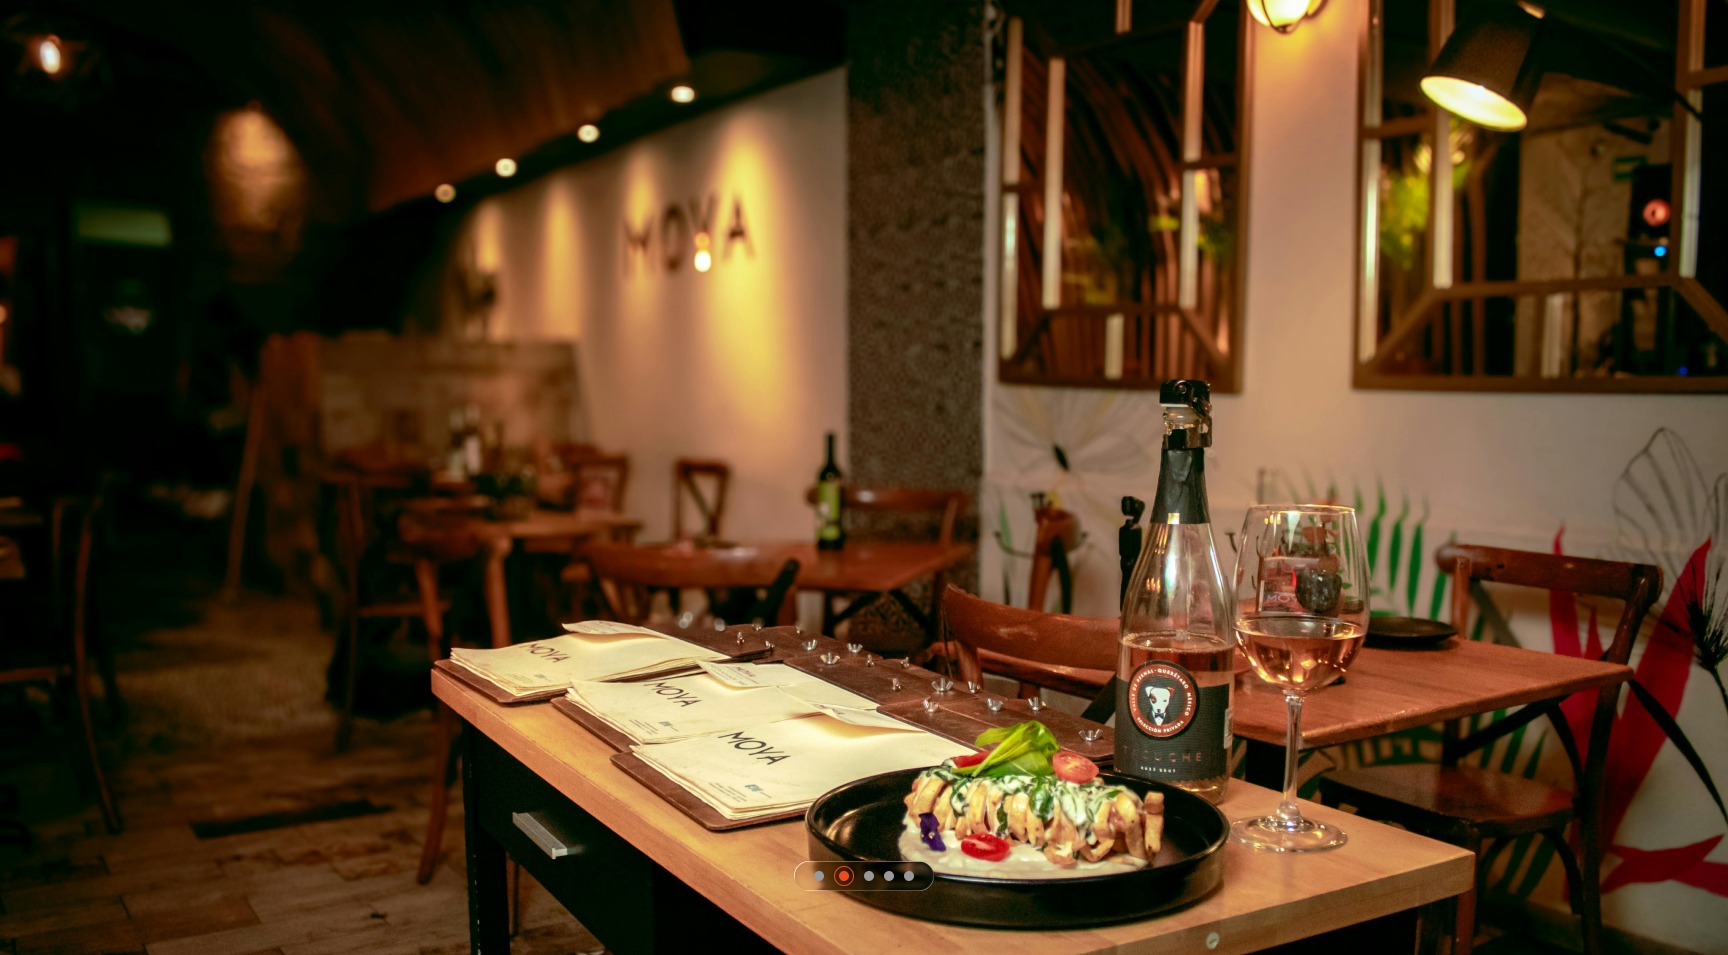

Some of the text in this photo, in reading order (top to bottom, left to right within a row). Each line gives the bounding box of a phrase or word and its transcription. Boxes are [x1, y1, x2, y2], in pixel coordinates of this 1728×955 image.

[622, 194, 757, 275] MOYA
[518, 643, 571, 664] MOYA
[1157, 668, 1189, 689] QUERÉTARO
[643, 682, 702, 707] MOYA
[1137, 716, 1184, 733] SELECCIÓN PRIVADA
[717, 731, 791, 765] MOYA
